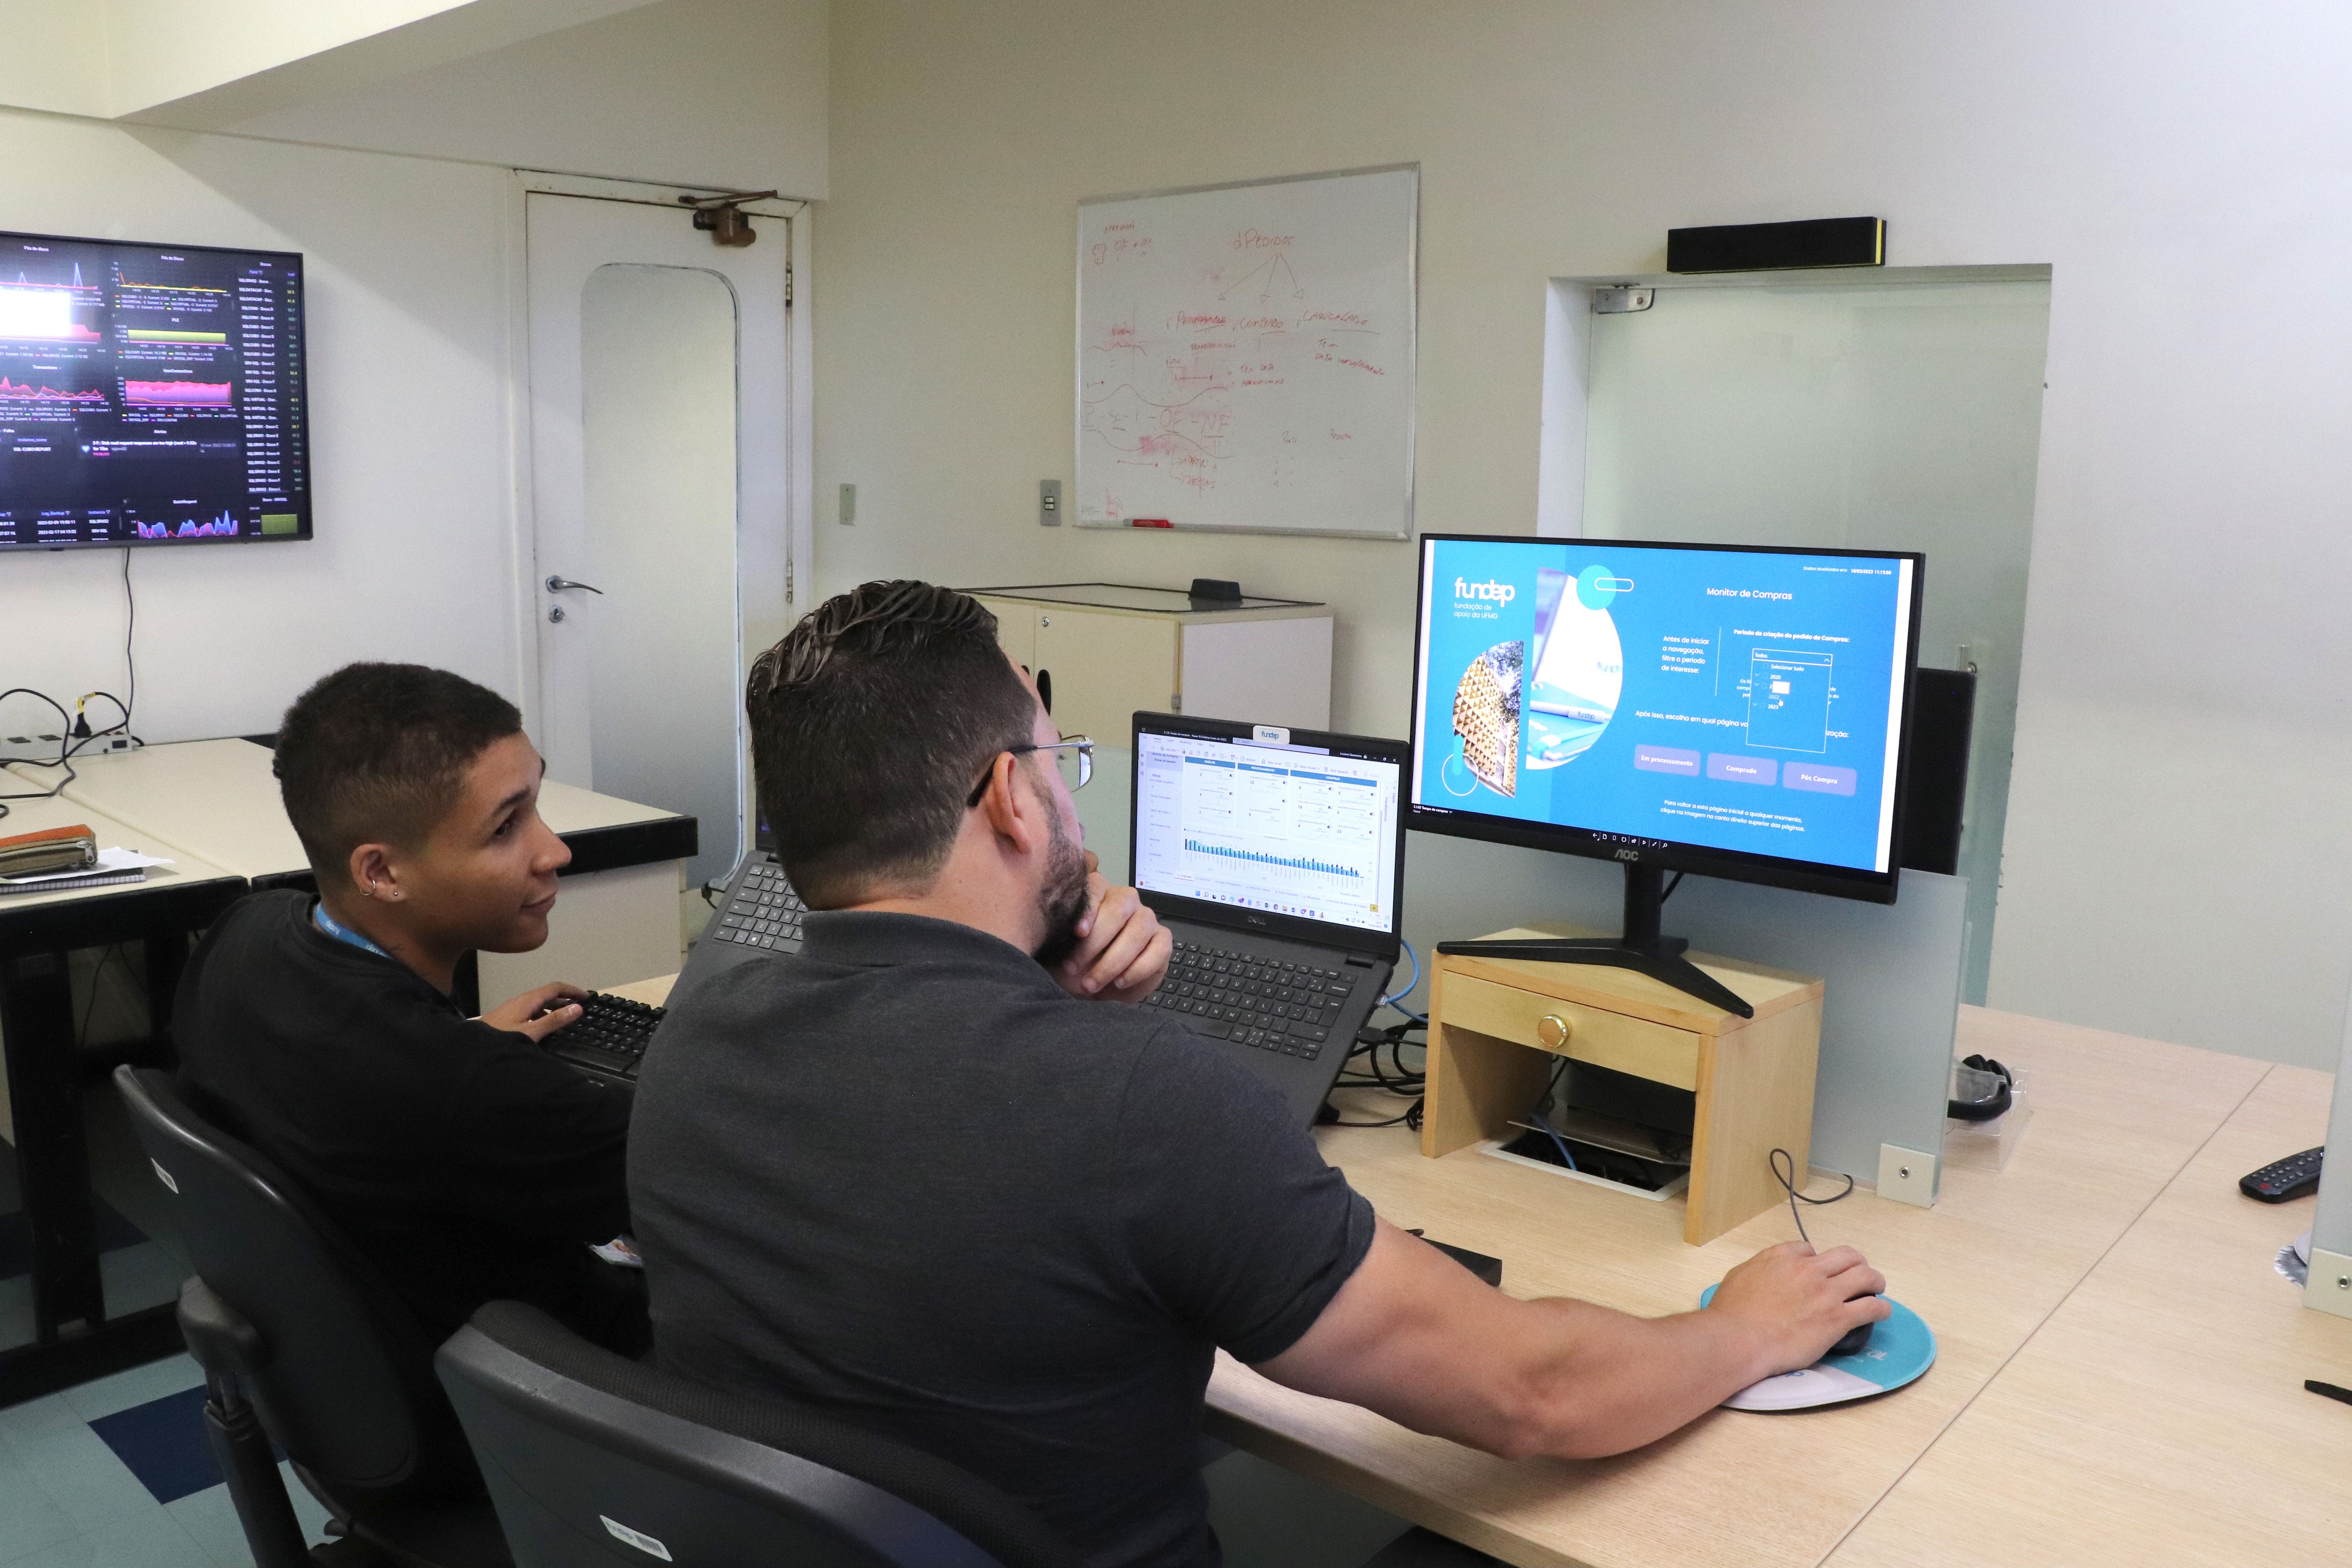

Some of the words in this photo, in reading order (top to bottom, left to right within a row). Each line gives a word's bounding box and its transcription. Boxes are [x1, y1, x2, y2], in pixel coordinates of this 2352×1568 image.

[1455, 577, 1515, 607] fundep
[1707, 588, 1738, 597] Monitor
[1739, 589, 1751, 598] de
[1752, 590, 1793, 601] Compras
[1454, 602, 1483, 611] fundação
[1668, 646, 1704, 655] navegação,
[1670, 665, 1699, 673] interesse:
[1261, 730, 1279, 740] fundep
[1651, 757, 1693, 766] processamento
[1726, 765, 1757, 774] Comprado
[1801, 773, 1812, 782] Pós
[1813, 775, 1838, 784] Compra
[1774, 815, 1802, 823] momento,
[1614, 848, 1639, 861] AOC
